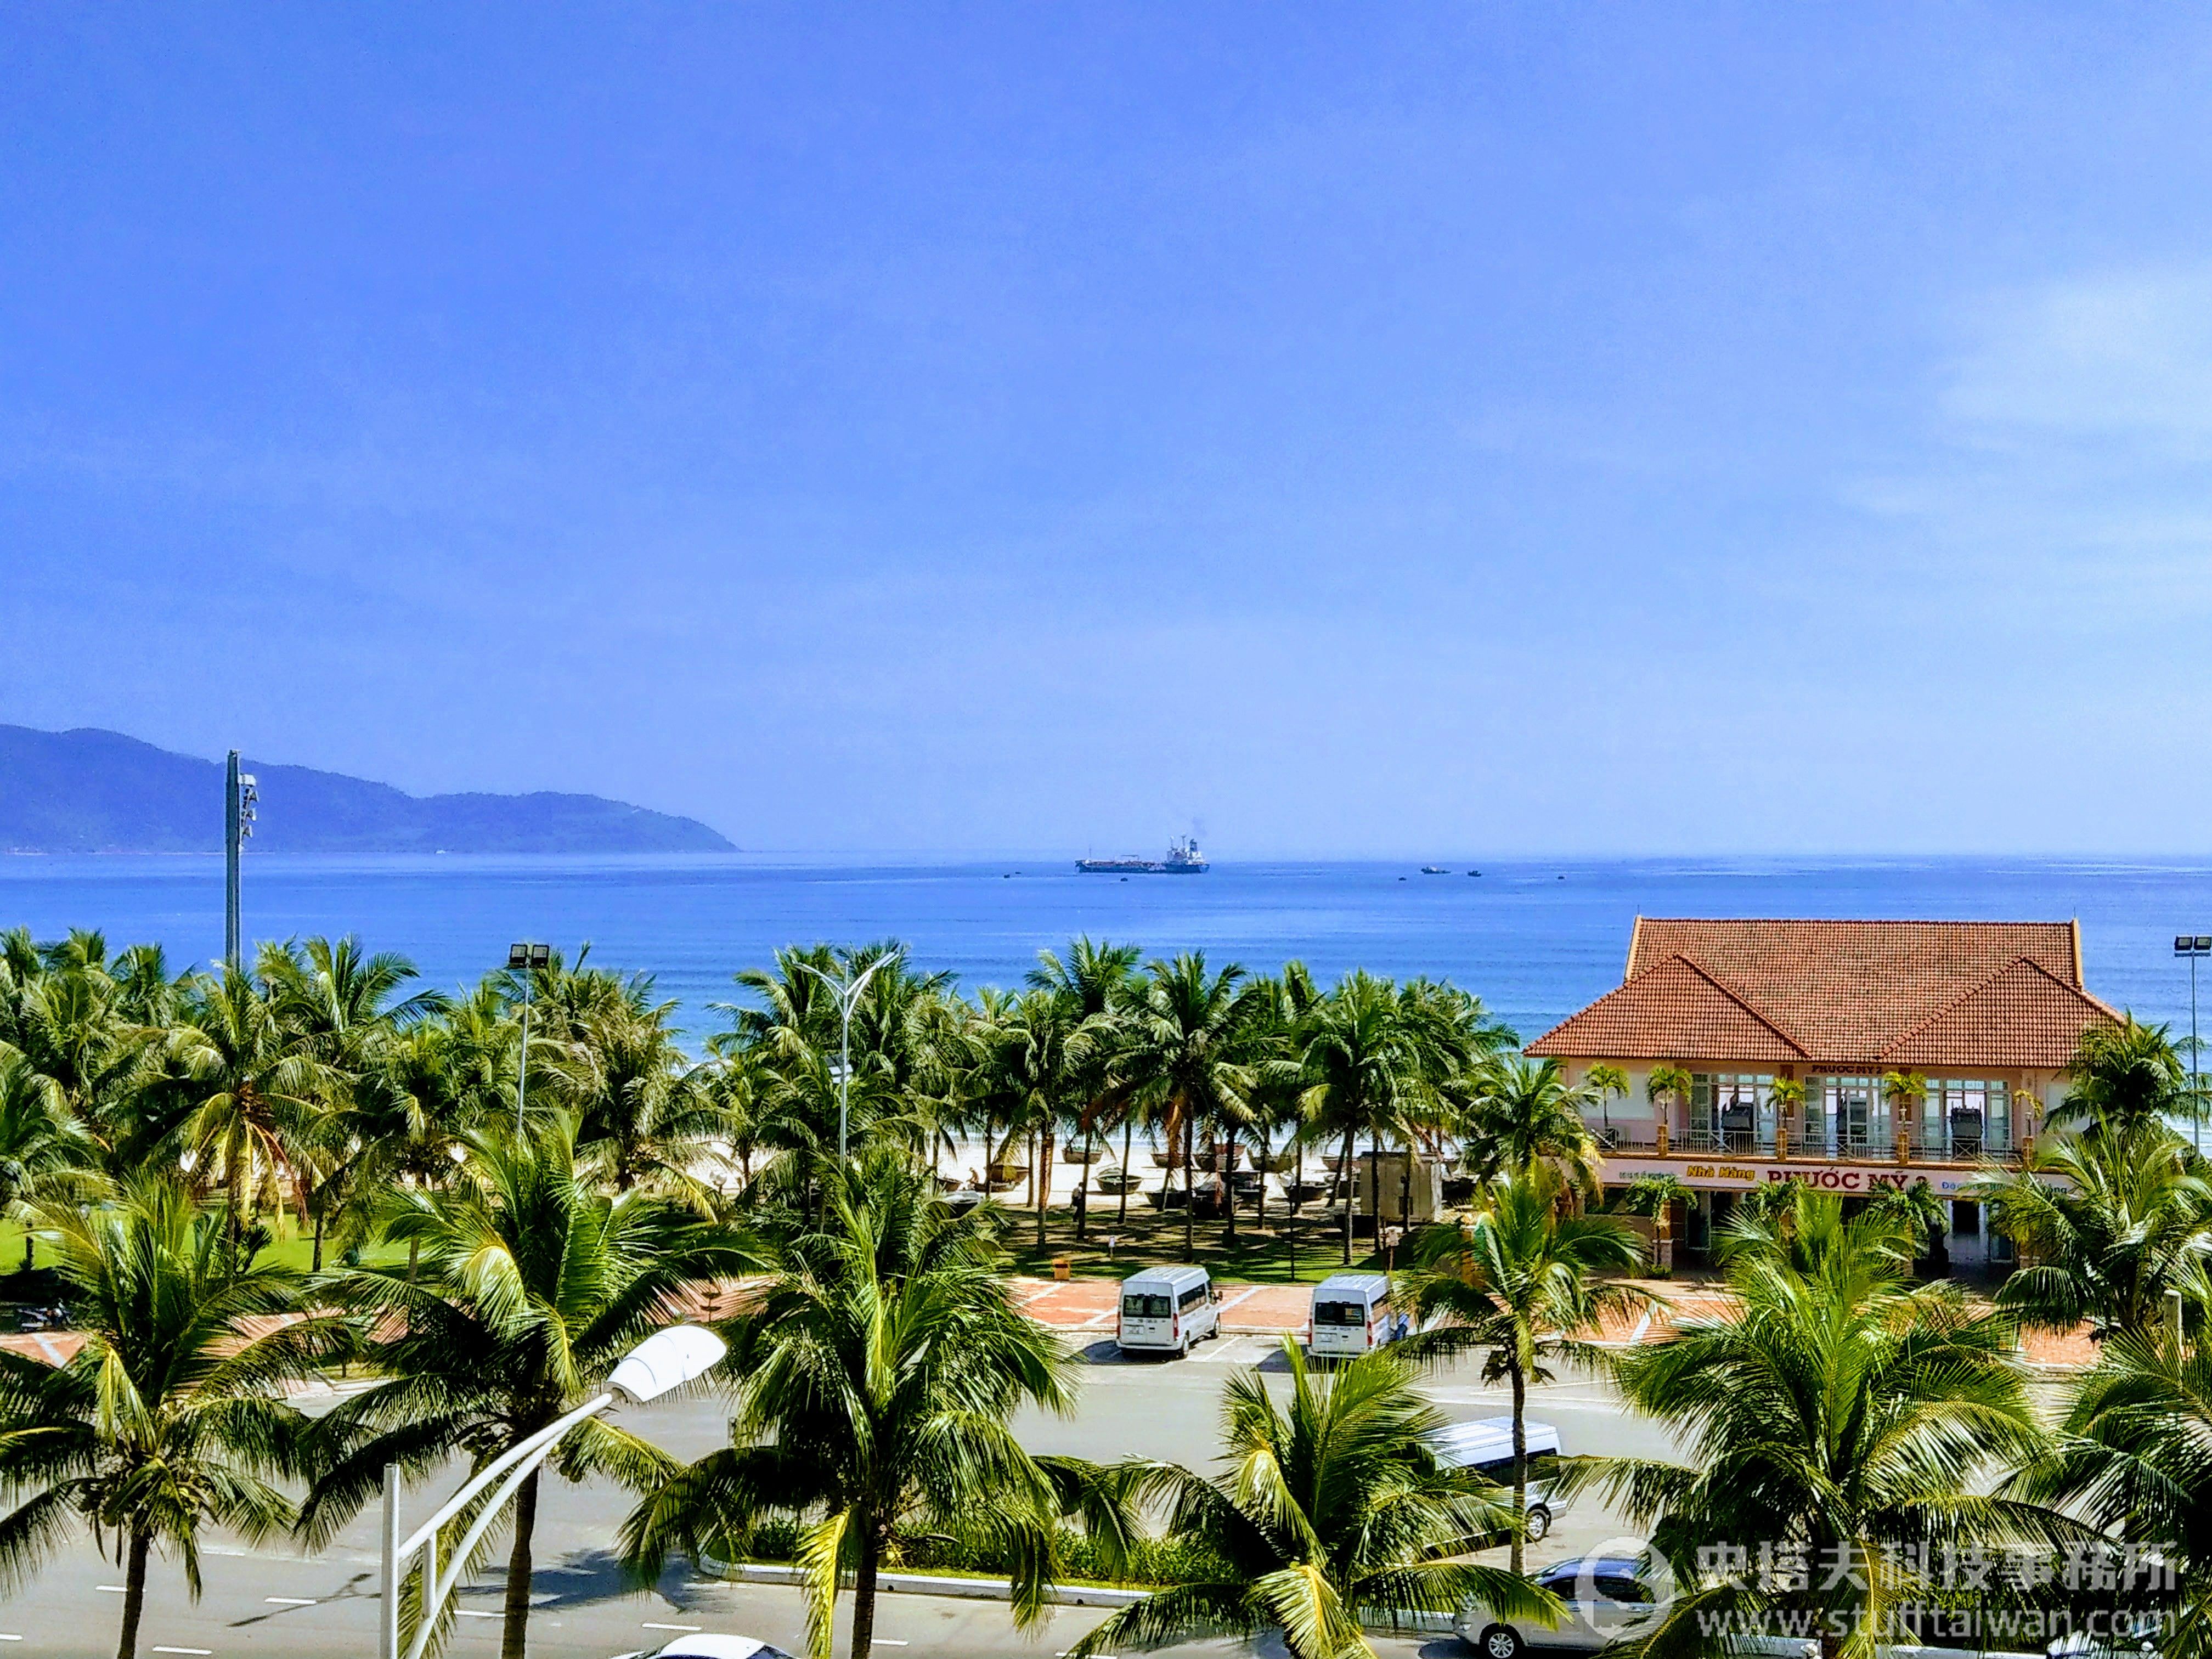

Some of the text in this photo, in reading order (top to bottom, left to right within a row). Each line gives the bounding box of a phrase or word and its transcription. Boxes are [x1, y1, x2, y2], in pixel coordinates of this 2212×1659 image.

[1876, 1066, 1882, 1074] 2
[1687, 1165, 1714, 1177] Nhà
[1718, 1167, 1755, 1181] Hàng
[1867, 1170, 1908, 1191] MỸ
